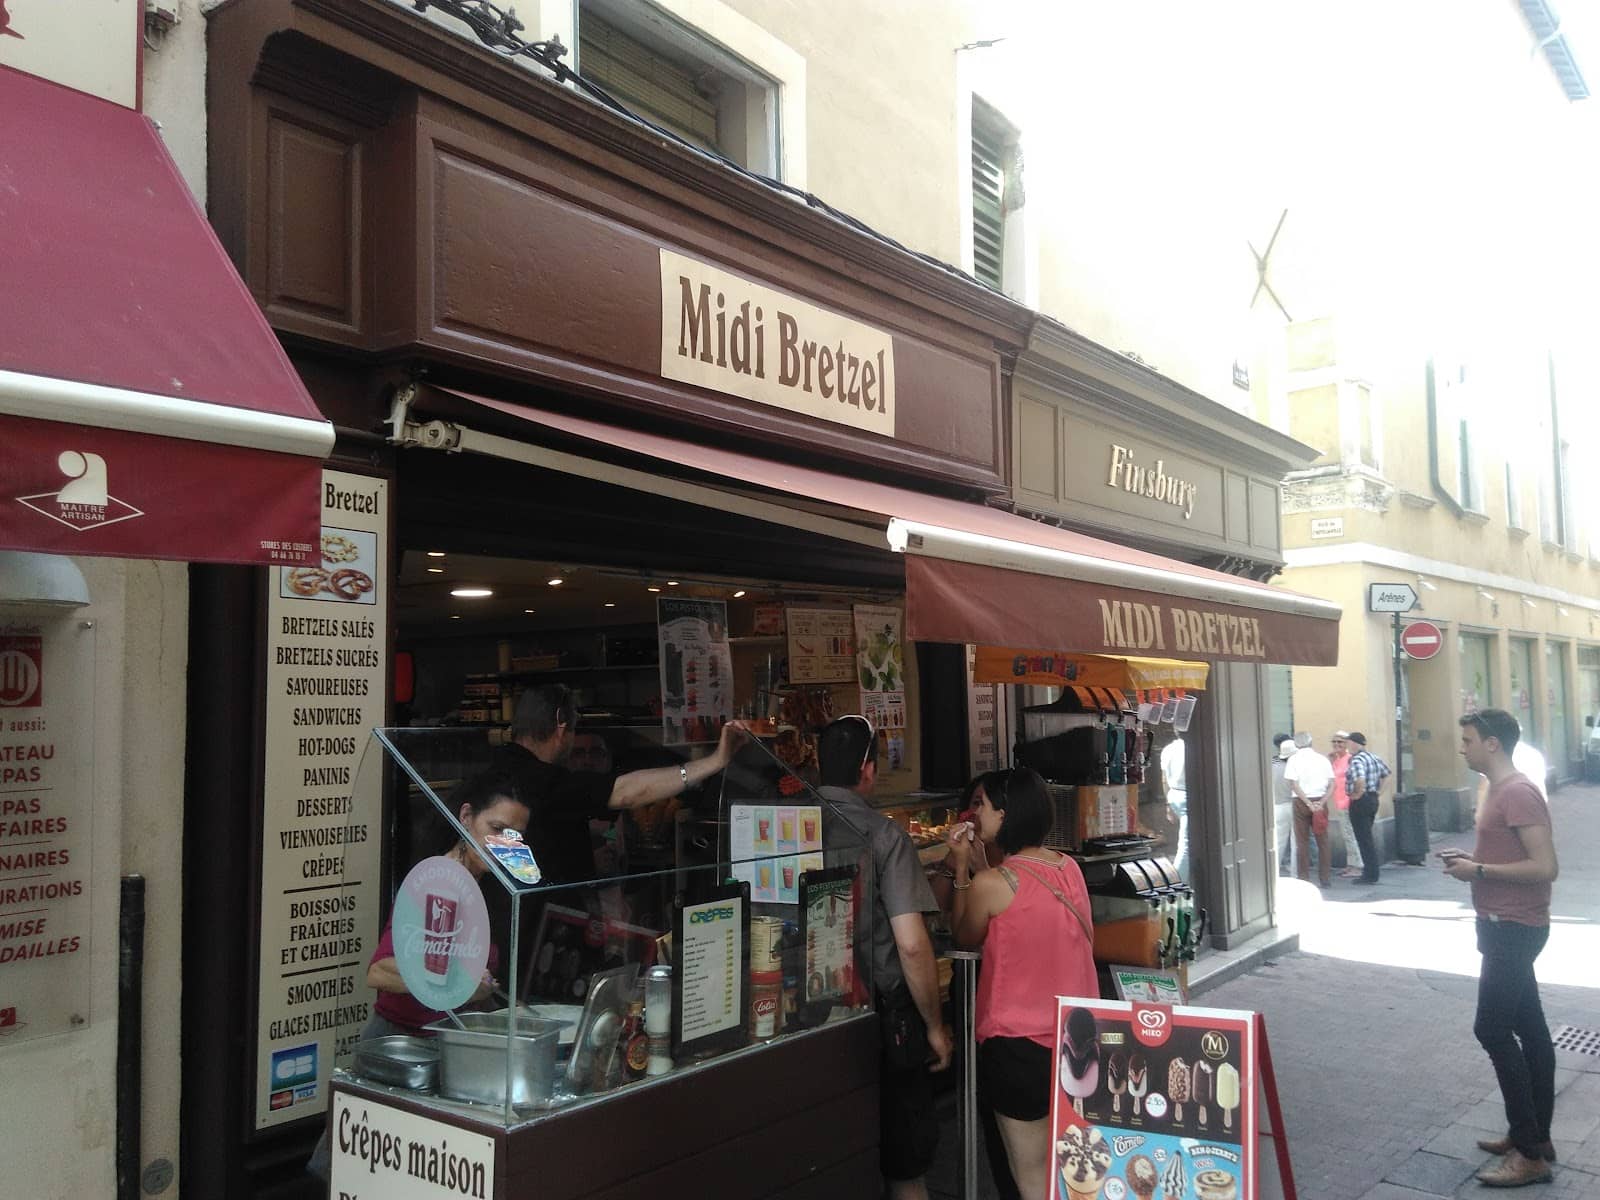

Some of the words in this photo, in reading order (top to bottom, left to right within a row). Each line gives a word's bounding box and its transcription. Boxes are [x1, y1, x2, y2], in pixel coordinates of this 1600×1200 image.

[679, 276, 765, 379] Midi
[777, 310, 886, 414] Bretzel
[1107, 444, 1196, 519] Finsbury
[61, 504, 104, 513] MAITRE
[325, 482, 378, 514] Bretzel
[61, 512, 104, 520] ARTISAN
[282, 617, 337, 636] BRETZELS
[341, 616, 374, 638] SALÉS
[1099, 599, 1166, 649] MIDI
[1171, 607, 1265, 658] BRETZEL
[277, 647, 332, 665] BRETZELS
[337, 645, 378, 667] SUCRÉS
[287, 678, 368, 696] SAVOUREUSES
[10, 717, 46, 732] aussi:
[293, 708, 361, 725] SANDWICHS
[299, 738, 355, 756] HOT-DOGS
[0, 767, 41, 783] PAS
[304, 767, 350, 786] PANINIS
[0, 798, 41, 816] PAS
[297, 797, 352, 817] DESSERTS
[280, 825, 367, 849] VIENNOISERIES
[290, 896, 356, 918] BOISSONS
[290, 917, 354, 941] FRAÎCHES
[281, 948, 297, 965] ET
[301, 938, 361, 961] CHAUDES
[287, 976, 354, 1005] SMOOTHES
[270, 1015, 309, 1040] GLACES
[312, 1003, 368, 1031] ITALIENNES
[1141, 1029, 1163, 1037] MIKO
[339, 1107, 401, 1174] Crêpes
[408, 1140, 485, 1200] maison
